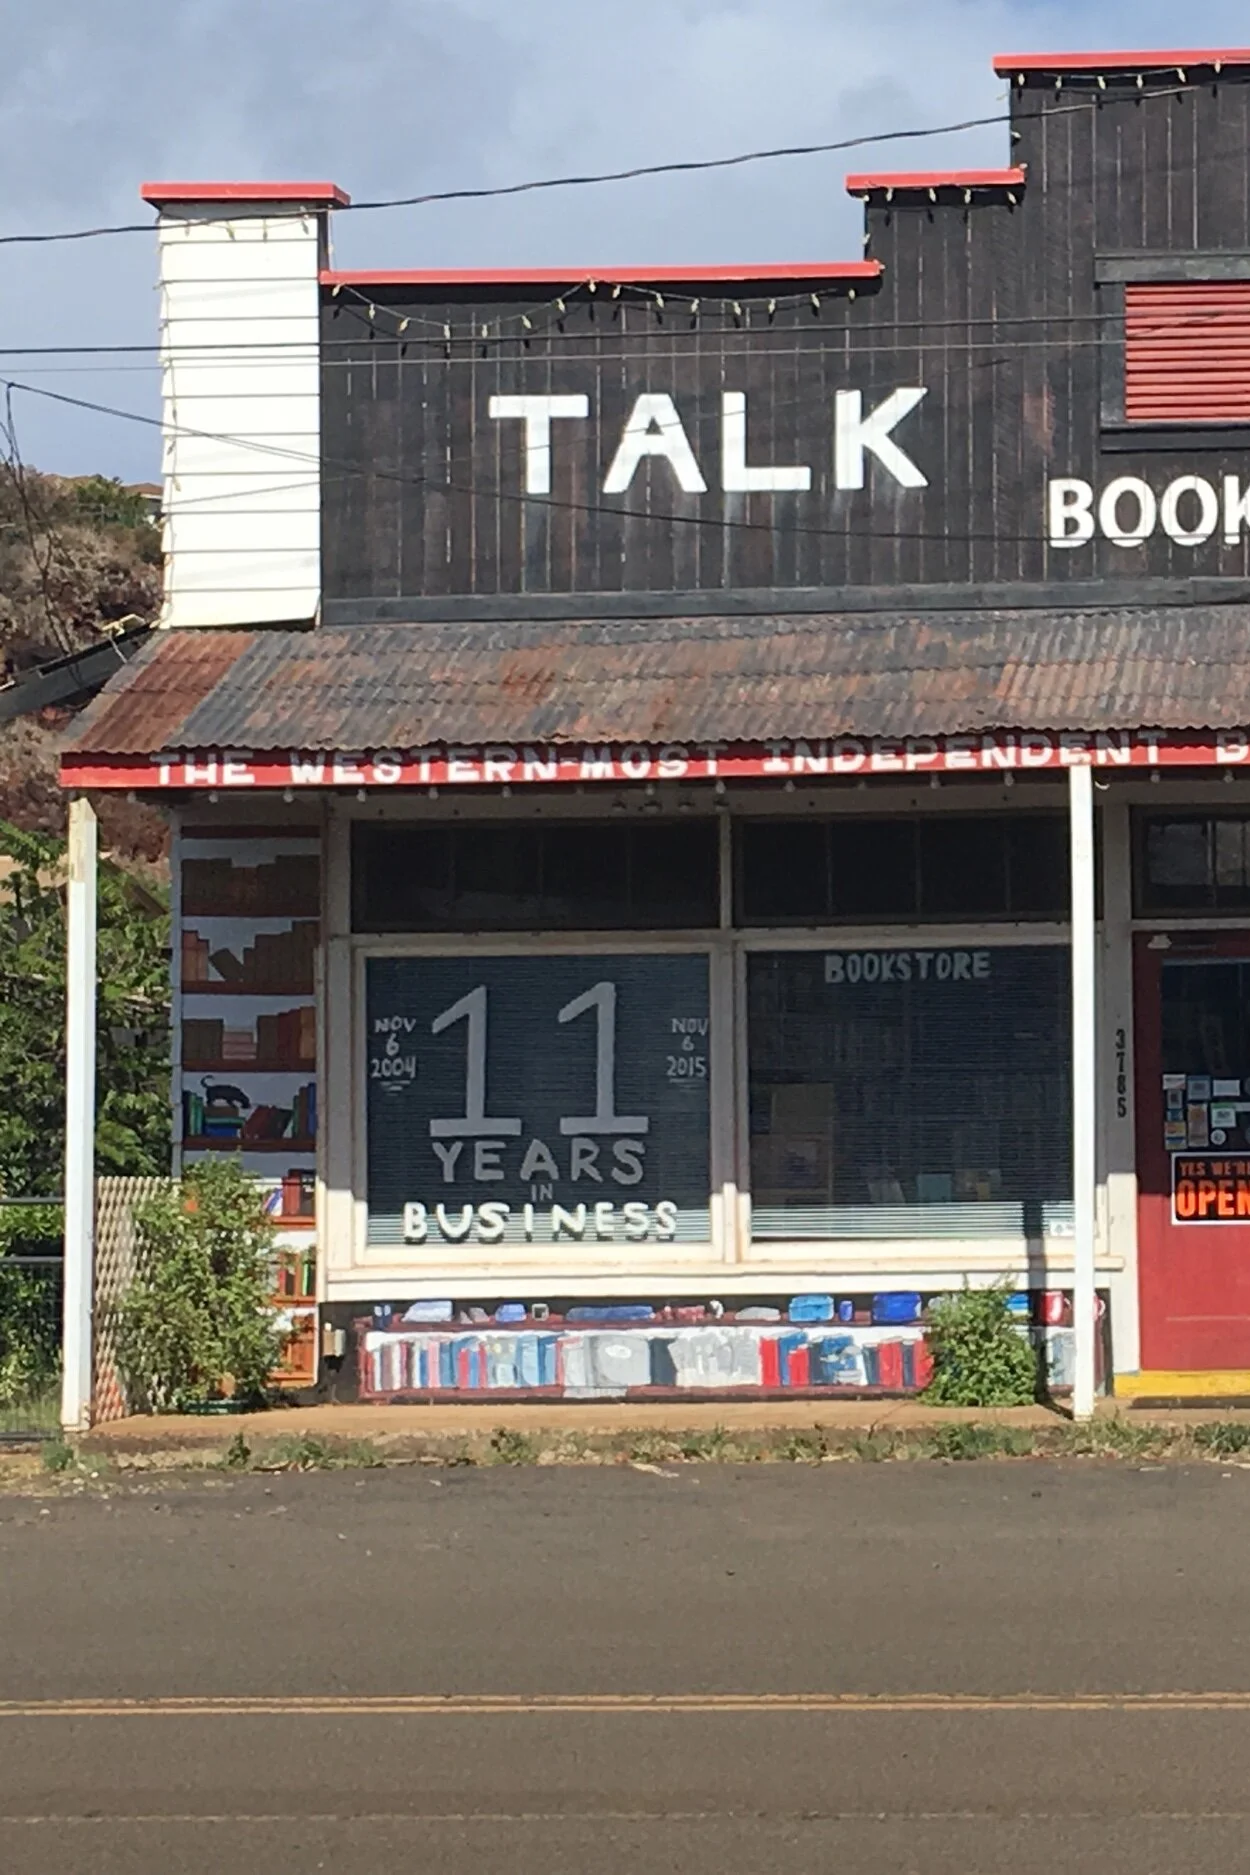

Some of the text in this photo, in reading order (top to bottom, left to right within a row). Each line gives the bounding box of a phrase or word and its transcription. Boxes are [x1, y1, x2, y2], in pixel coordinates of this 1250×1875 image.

[488, 387, 929, 494] TALK
[151, 751, 256, 785] THE
[289, 742, 728, 784] WESTERN-MOST
[763, 730, 1167, 773] INDEPENDENT
[824, 951, 992, 983] BOOKSTORE
[374, 1015, 417, 1033] NOV
[671, 1017, 709, 1036] NOV
[386, 1032, 400, 1056] 6
[681, 1035, 695, 1051] 6
[371, 1056, 416, 1078] 2004
[430, 981, 649, 1138] 11
[666, 1055, 707, 1077] 2015
[432, 1138, 646, 1185] YEARS
[1180, 1161, 1206, 1176] YES
[532, 1183, 553, 1201] IN
[403, 1200, 678, 1241] BUSINESS
